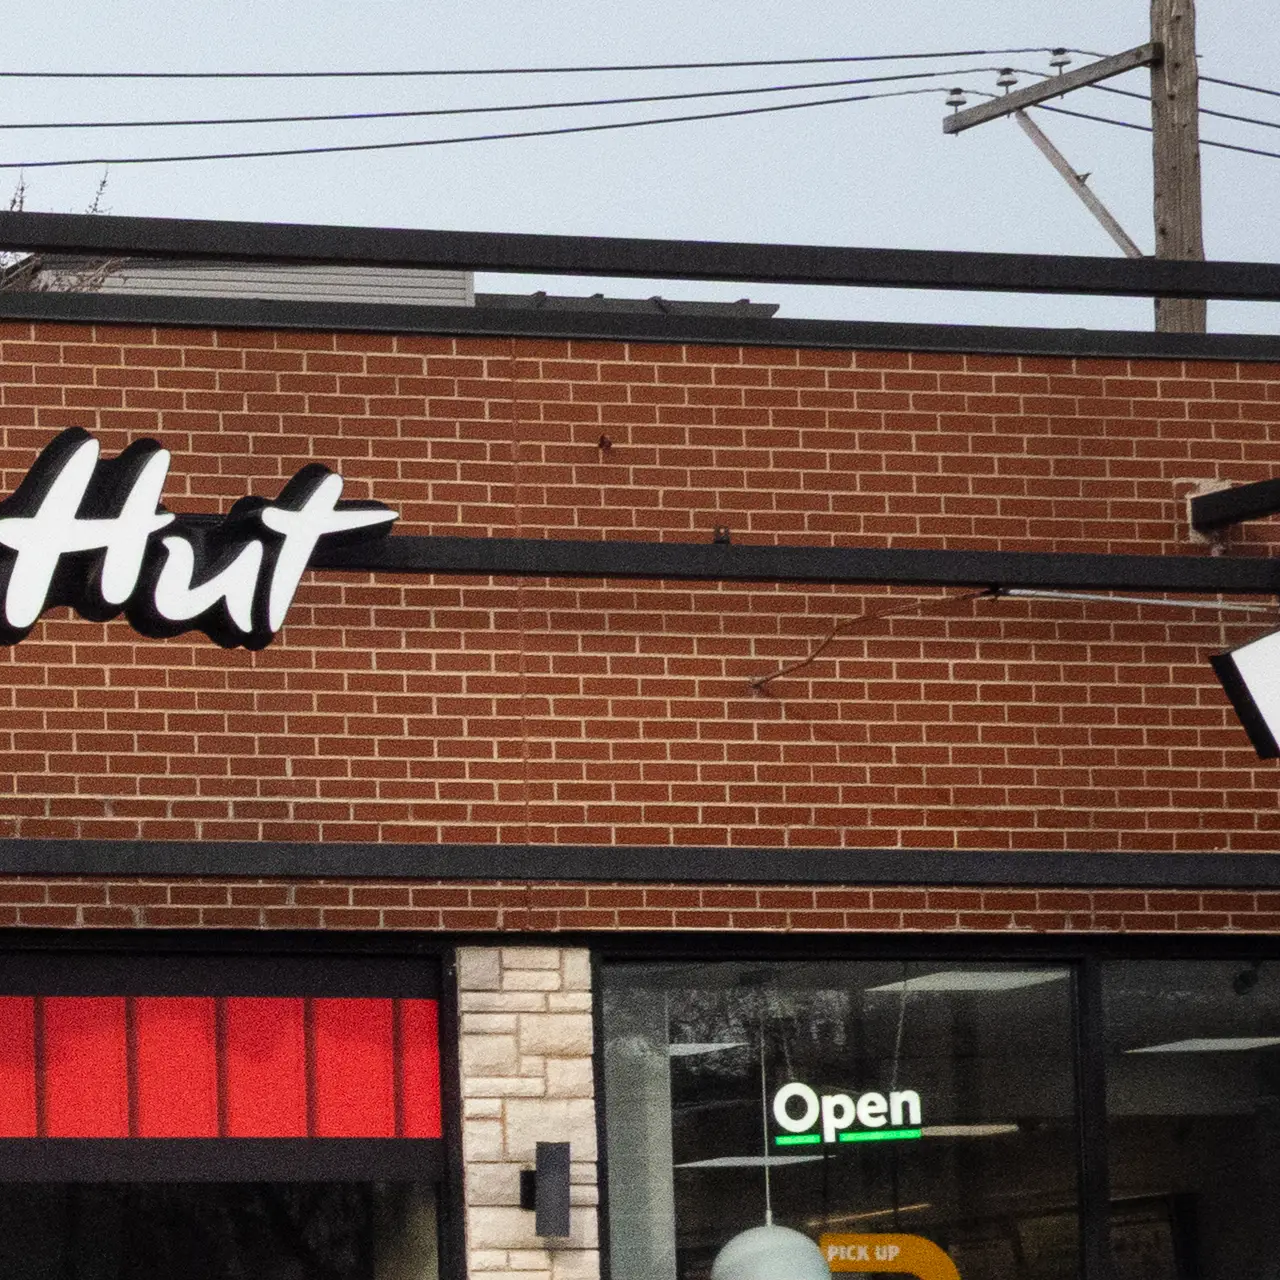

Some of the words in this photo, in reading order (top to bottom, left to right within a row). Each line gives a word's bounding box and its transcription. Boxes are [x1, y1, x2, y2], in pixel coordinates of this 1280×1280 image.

[773, 1082, 922, 1143] Open
[827, 1245, 870, 1261] PICK
[875, 1245, 900, 1261] UP
